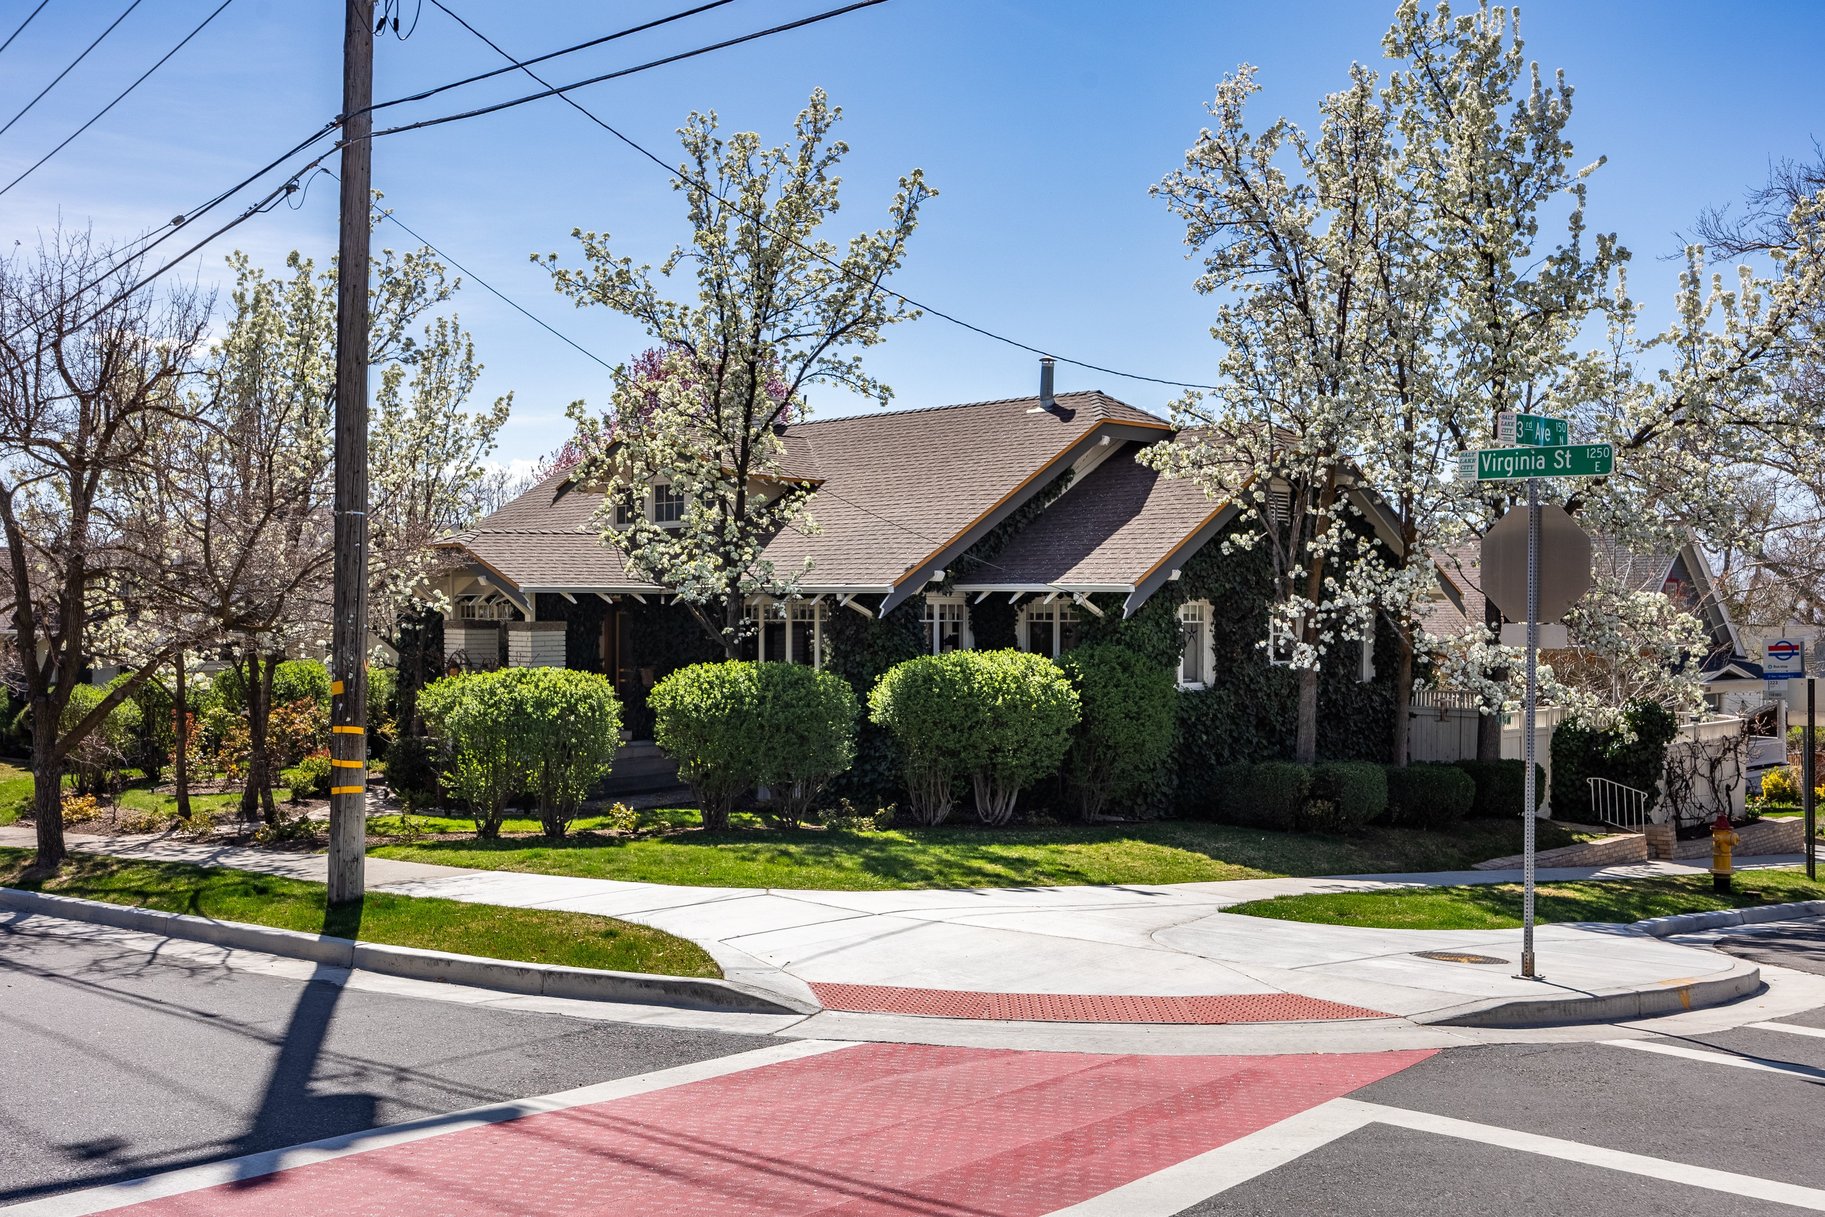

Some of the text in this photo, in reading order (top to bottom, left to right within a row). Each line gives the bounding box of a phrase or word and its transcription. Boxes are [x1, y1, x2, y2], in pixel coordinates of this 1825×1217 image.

[1516, 420, 1551, 442] 3rd Ave
[1556, 422, 1566, 433] 150
[1559, 436, 1564, 446] N
[1586, 447, 1610, 459] 1250
[1482, 449, 1572, 476] Virginia St
[1594, 461, 1601, 472] E
